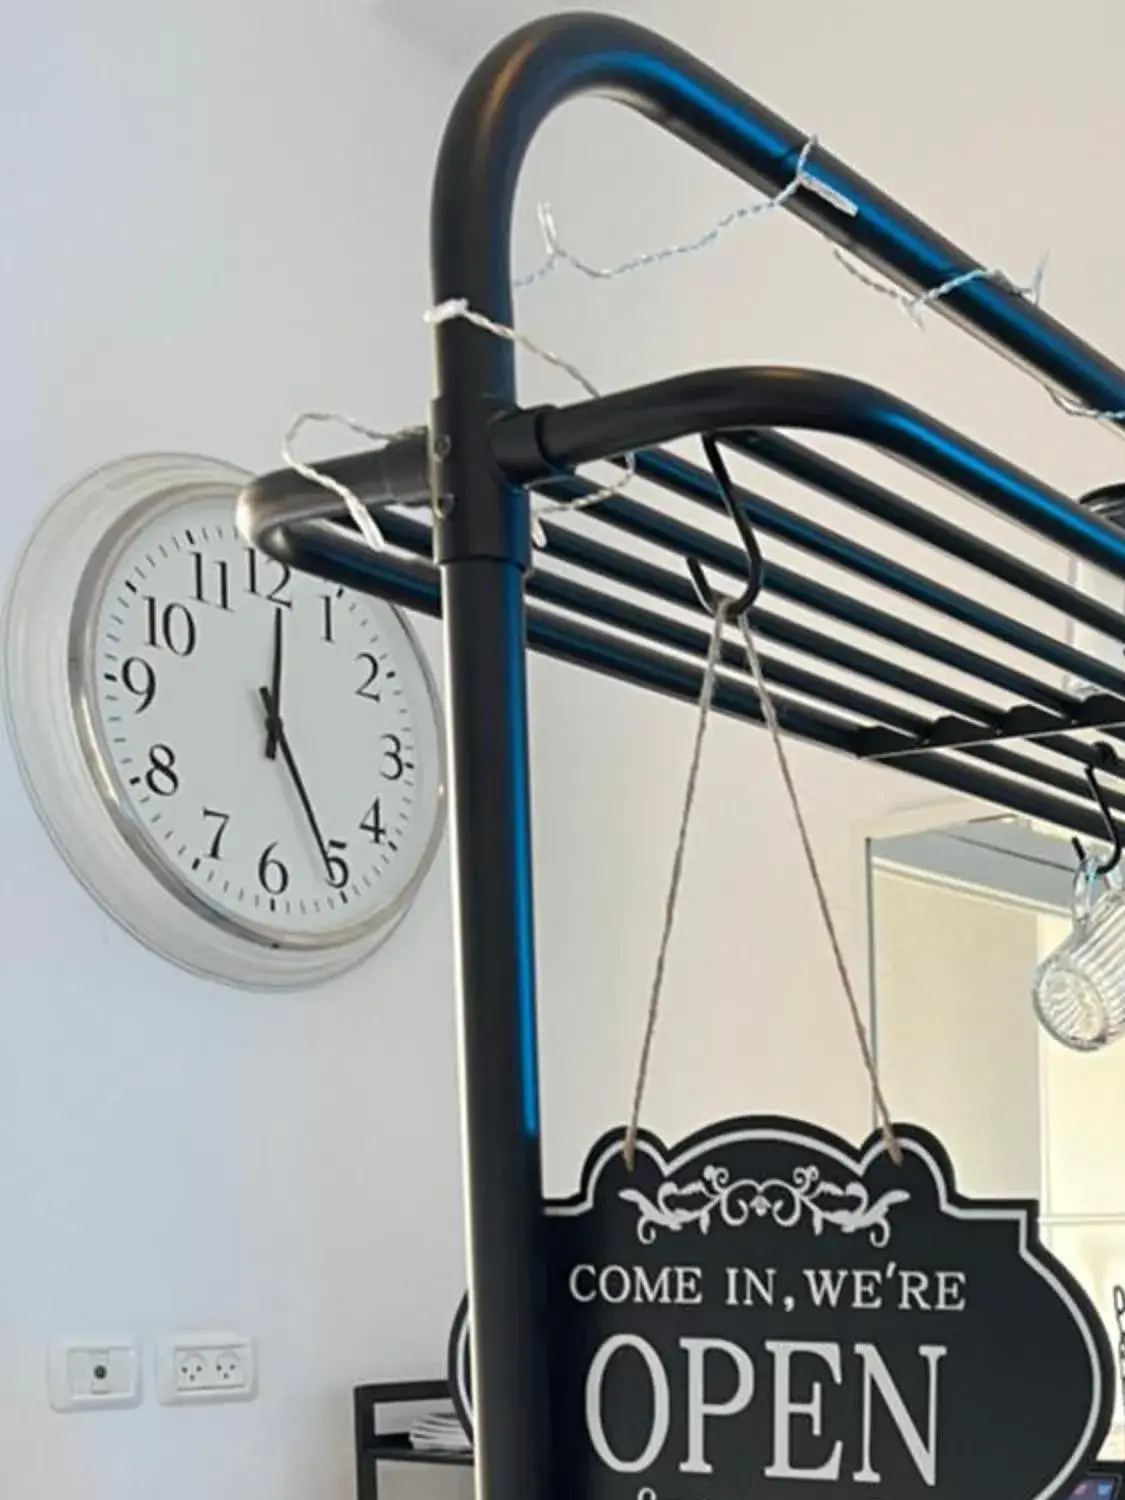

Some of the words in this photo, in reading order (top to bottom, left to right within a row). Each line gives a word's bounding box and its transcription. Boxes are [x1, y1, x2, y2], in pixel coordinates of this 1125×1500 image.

[188, 551, 236, 612] 11
[244, 546, 293, 608] 12
[142, 595, 196, 656] 10
[319, 593, 337, 642] 1
[121, 655, 157, 714] 9
[355, 653, 381, 703] 2
[145, 743, 179, 797] 8
[378, 733, 404, 781] 3
[201, 808, 231, 860] 7
[359, 796, 387, 845] 4
[258, 840, 290, 895] 6
[326, 840, 350, 889] 5
[568, 1263, 703, 1306] COME
[804, 1263, 967, 1311] WE'RE
[585, 1333, 948, 1488] OPEN
